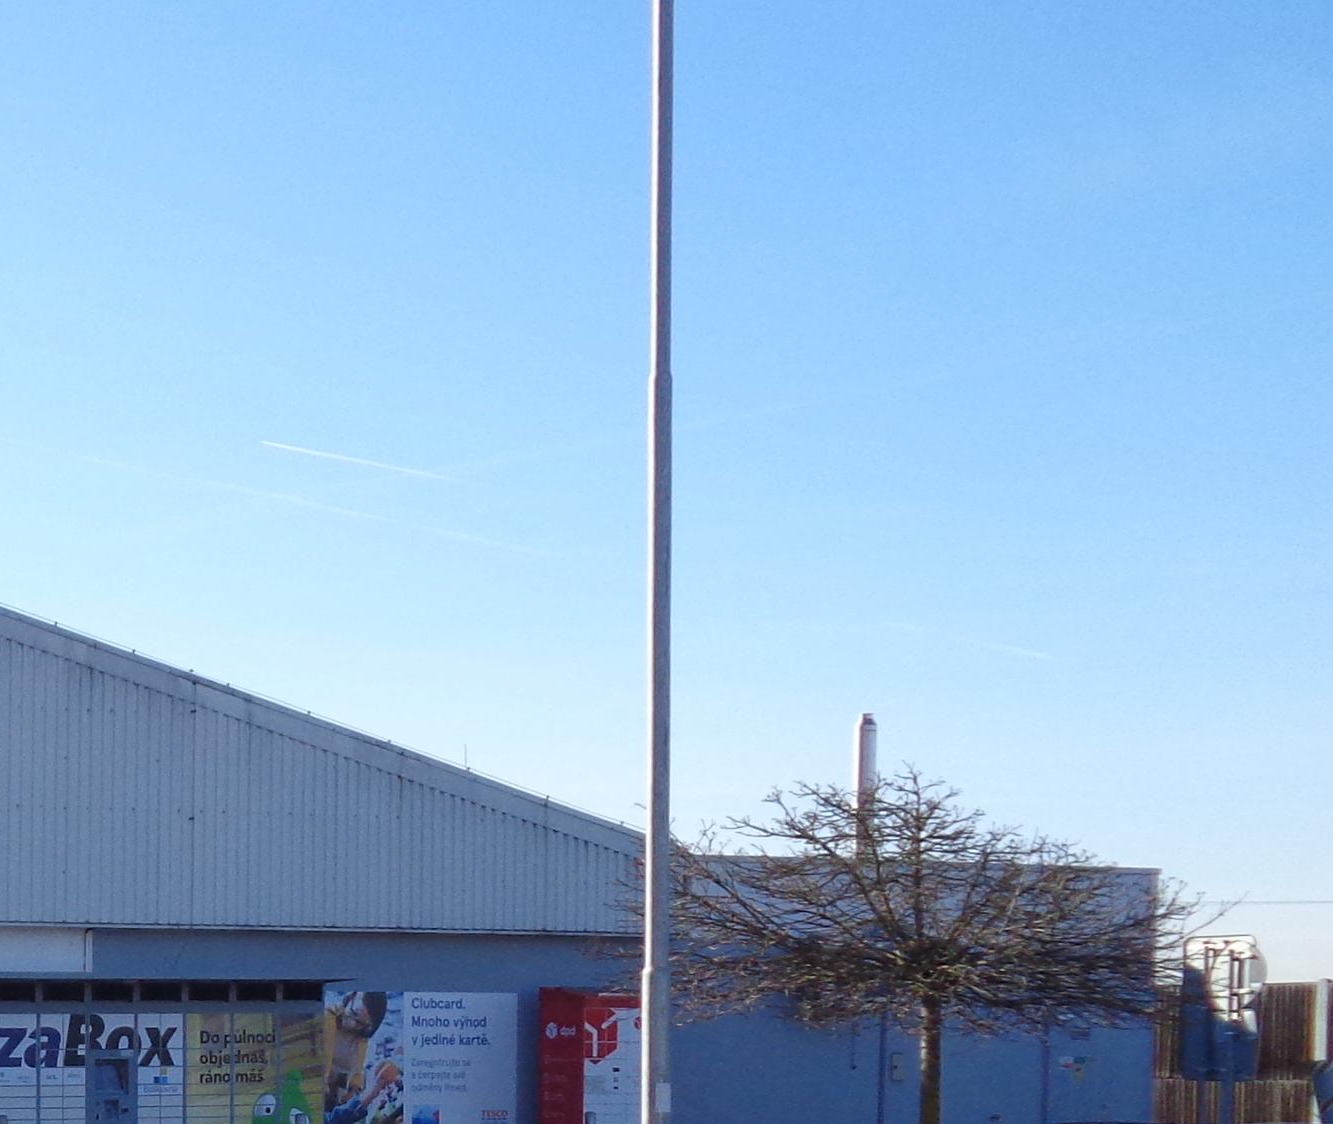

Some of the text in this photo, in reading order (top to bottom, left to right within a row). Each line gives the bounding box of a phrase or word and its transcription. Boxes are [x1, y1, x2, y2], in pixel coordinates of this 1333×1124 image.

[411, 997, 466, 1010] Clubcard.
[411, 1015, 487, 1030] Mnoho výhod
[199, 1030, 220, 1044] Do
[559, 1024, 576, 1037] dpd
[411, 1033, 491, 1048] v jediné kartě.
[199, 1049, 269, 1068] objednáš,
[199, 1067, 265, 1084] ráno máš
[480, 1109, 509, 1118] TESCO
